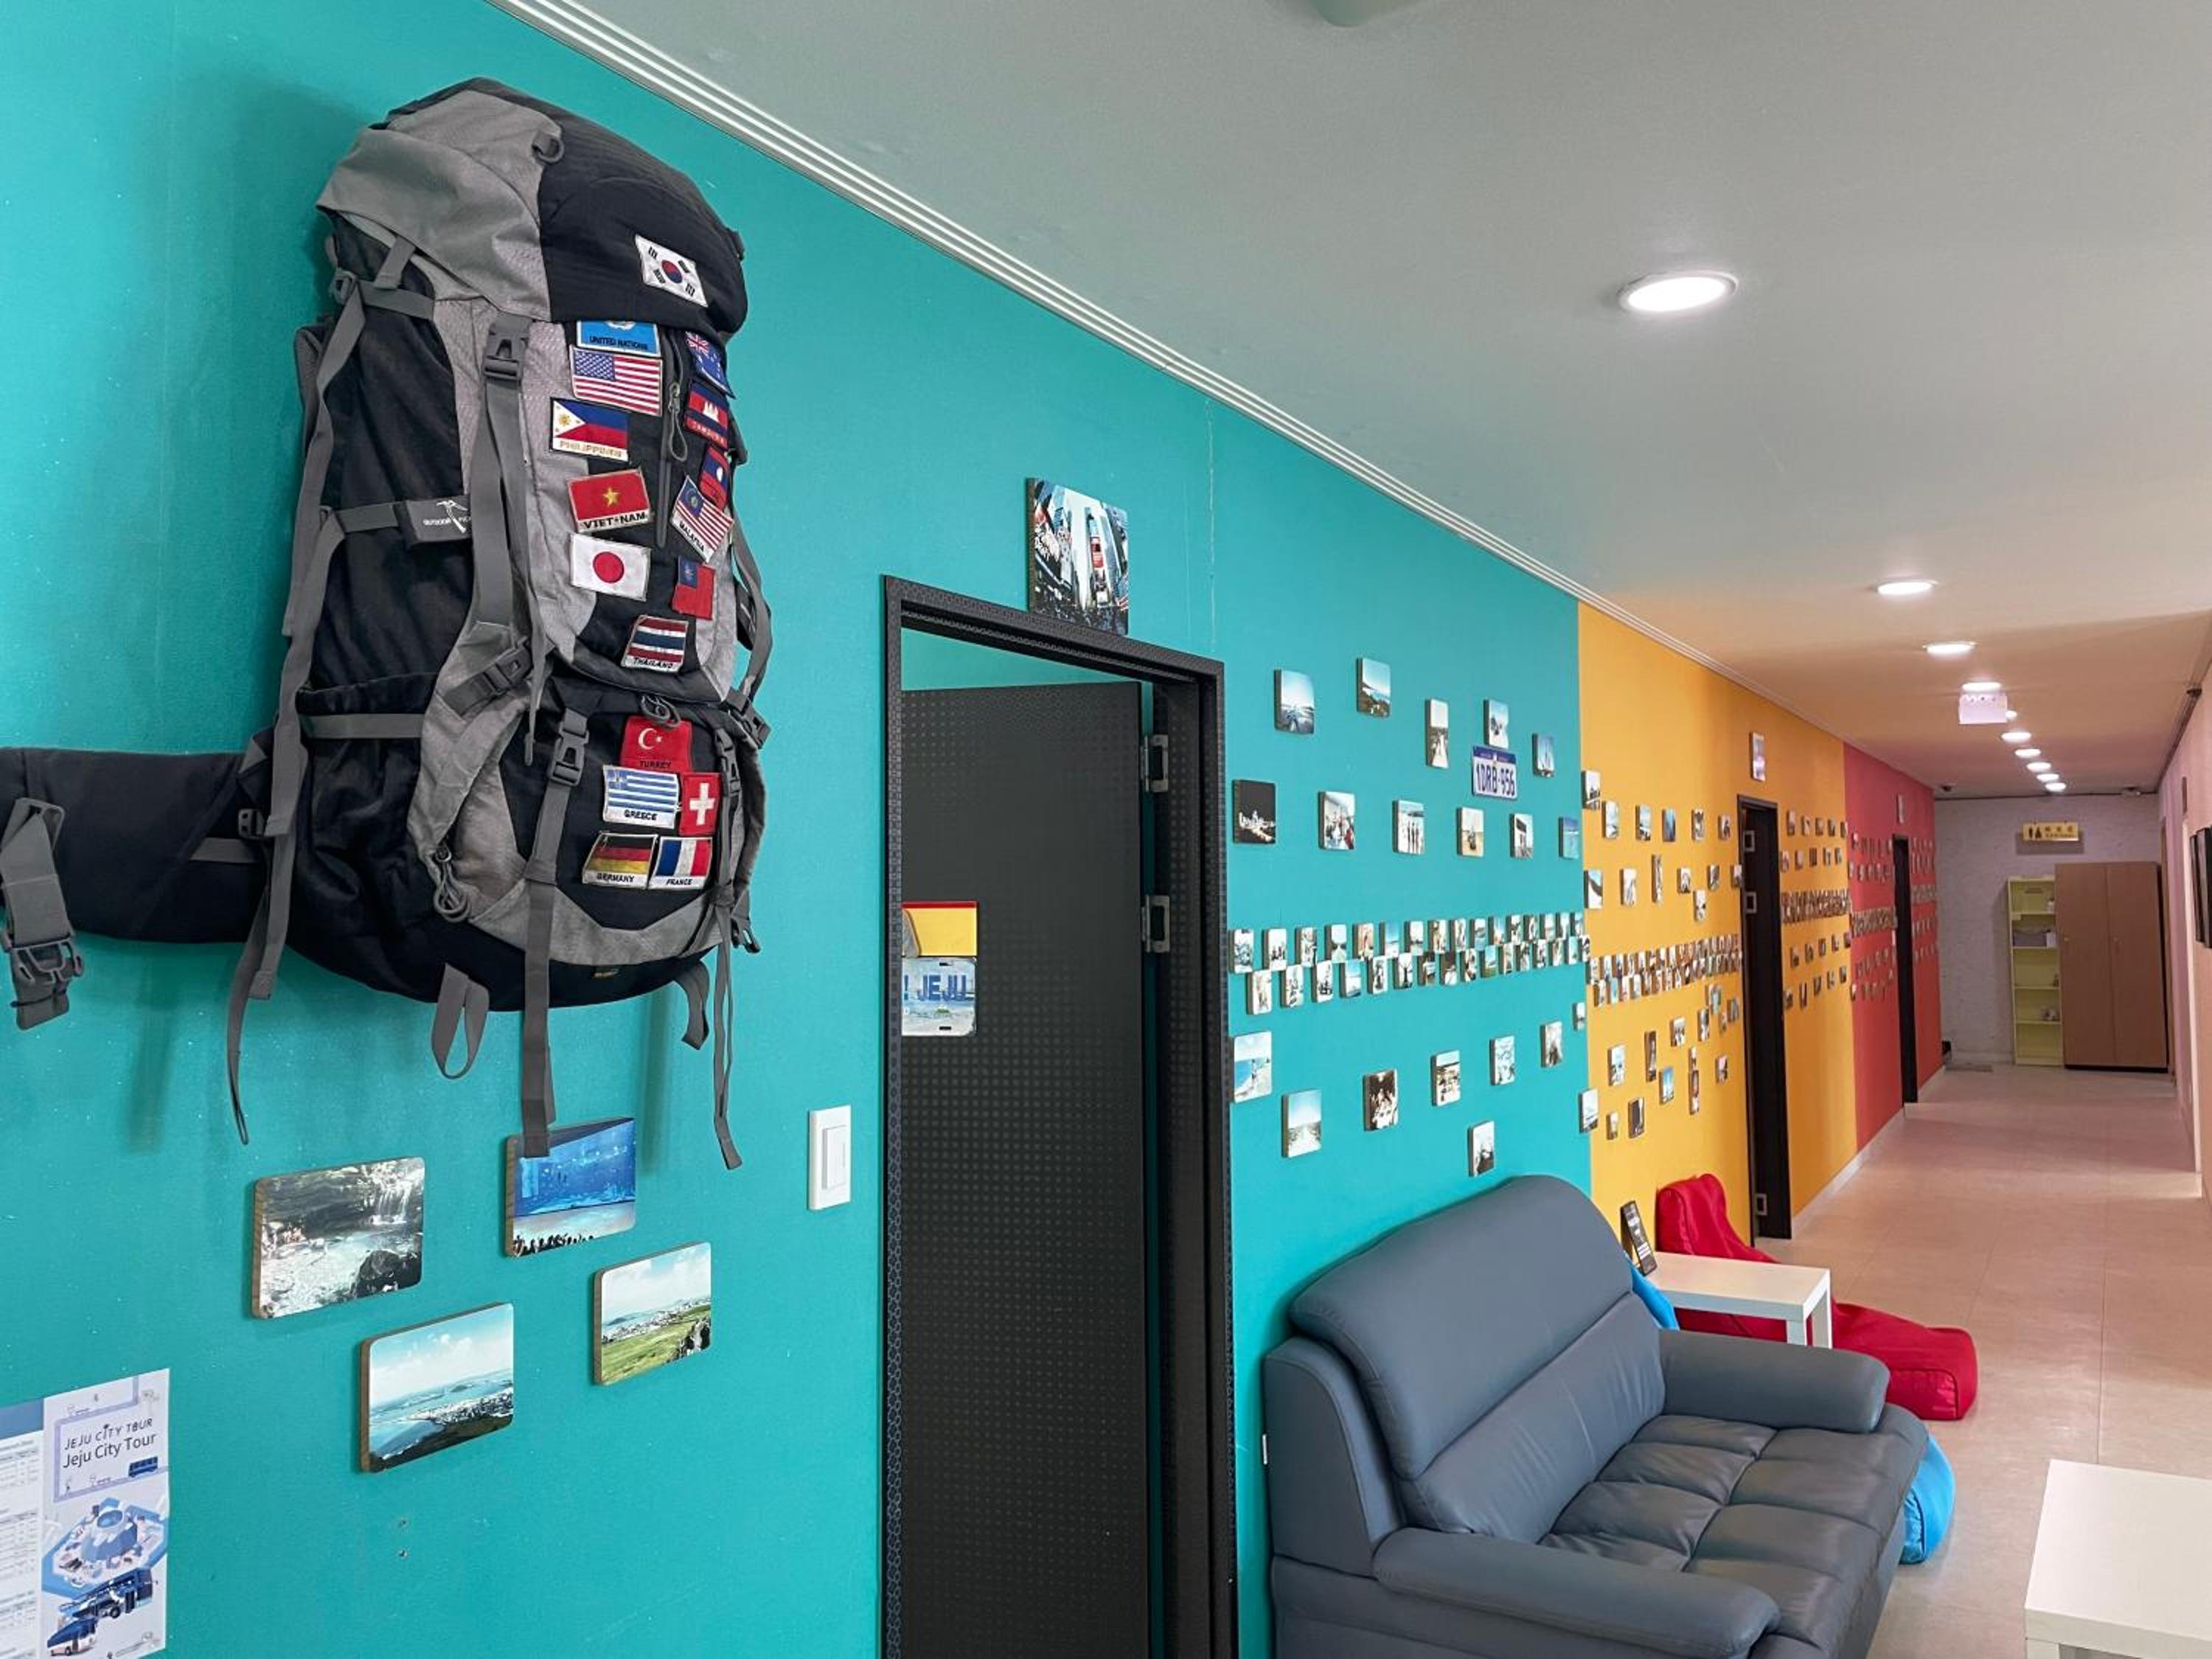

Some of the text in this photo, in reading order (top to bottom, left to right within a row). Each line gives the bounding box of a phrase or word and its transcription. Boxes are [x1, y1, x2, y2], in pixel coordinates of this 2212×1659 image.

[590, 335, 648, 350] UNITED NATIONS
[679, 520, 704, 552] MALAYSIA
[634, 657, 673, 669] THAILAND
[640, 760, 672, 769] TURKEY
[625, 809, 658, 821] GREECE
[597, 872, 635, 883] GERMANY
[917, 975, 967, 1001] JEJU
[65, 1433, 92, 1450] JEJU
[95, 1425, 123, 1441] CITY
[63, 1434, 156, 1468] Jeju City Tour
